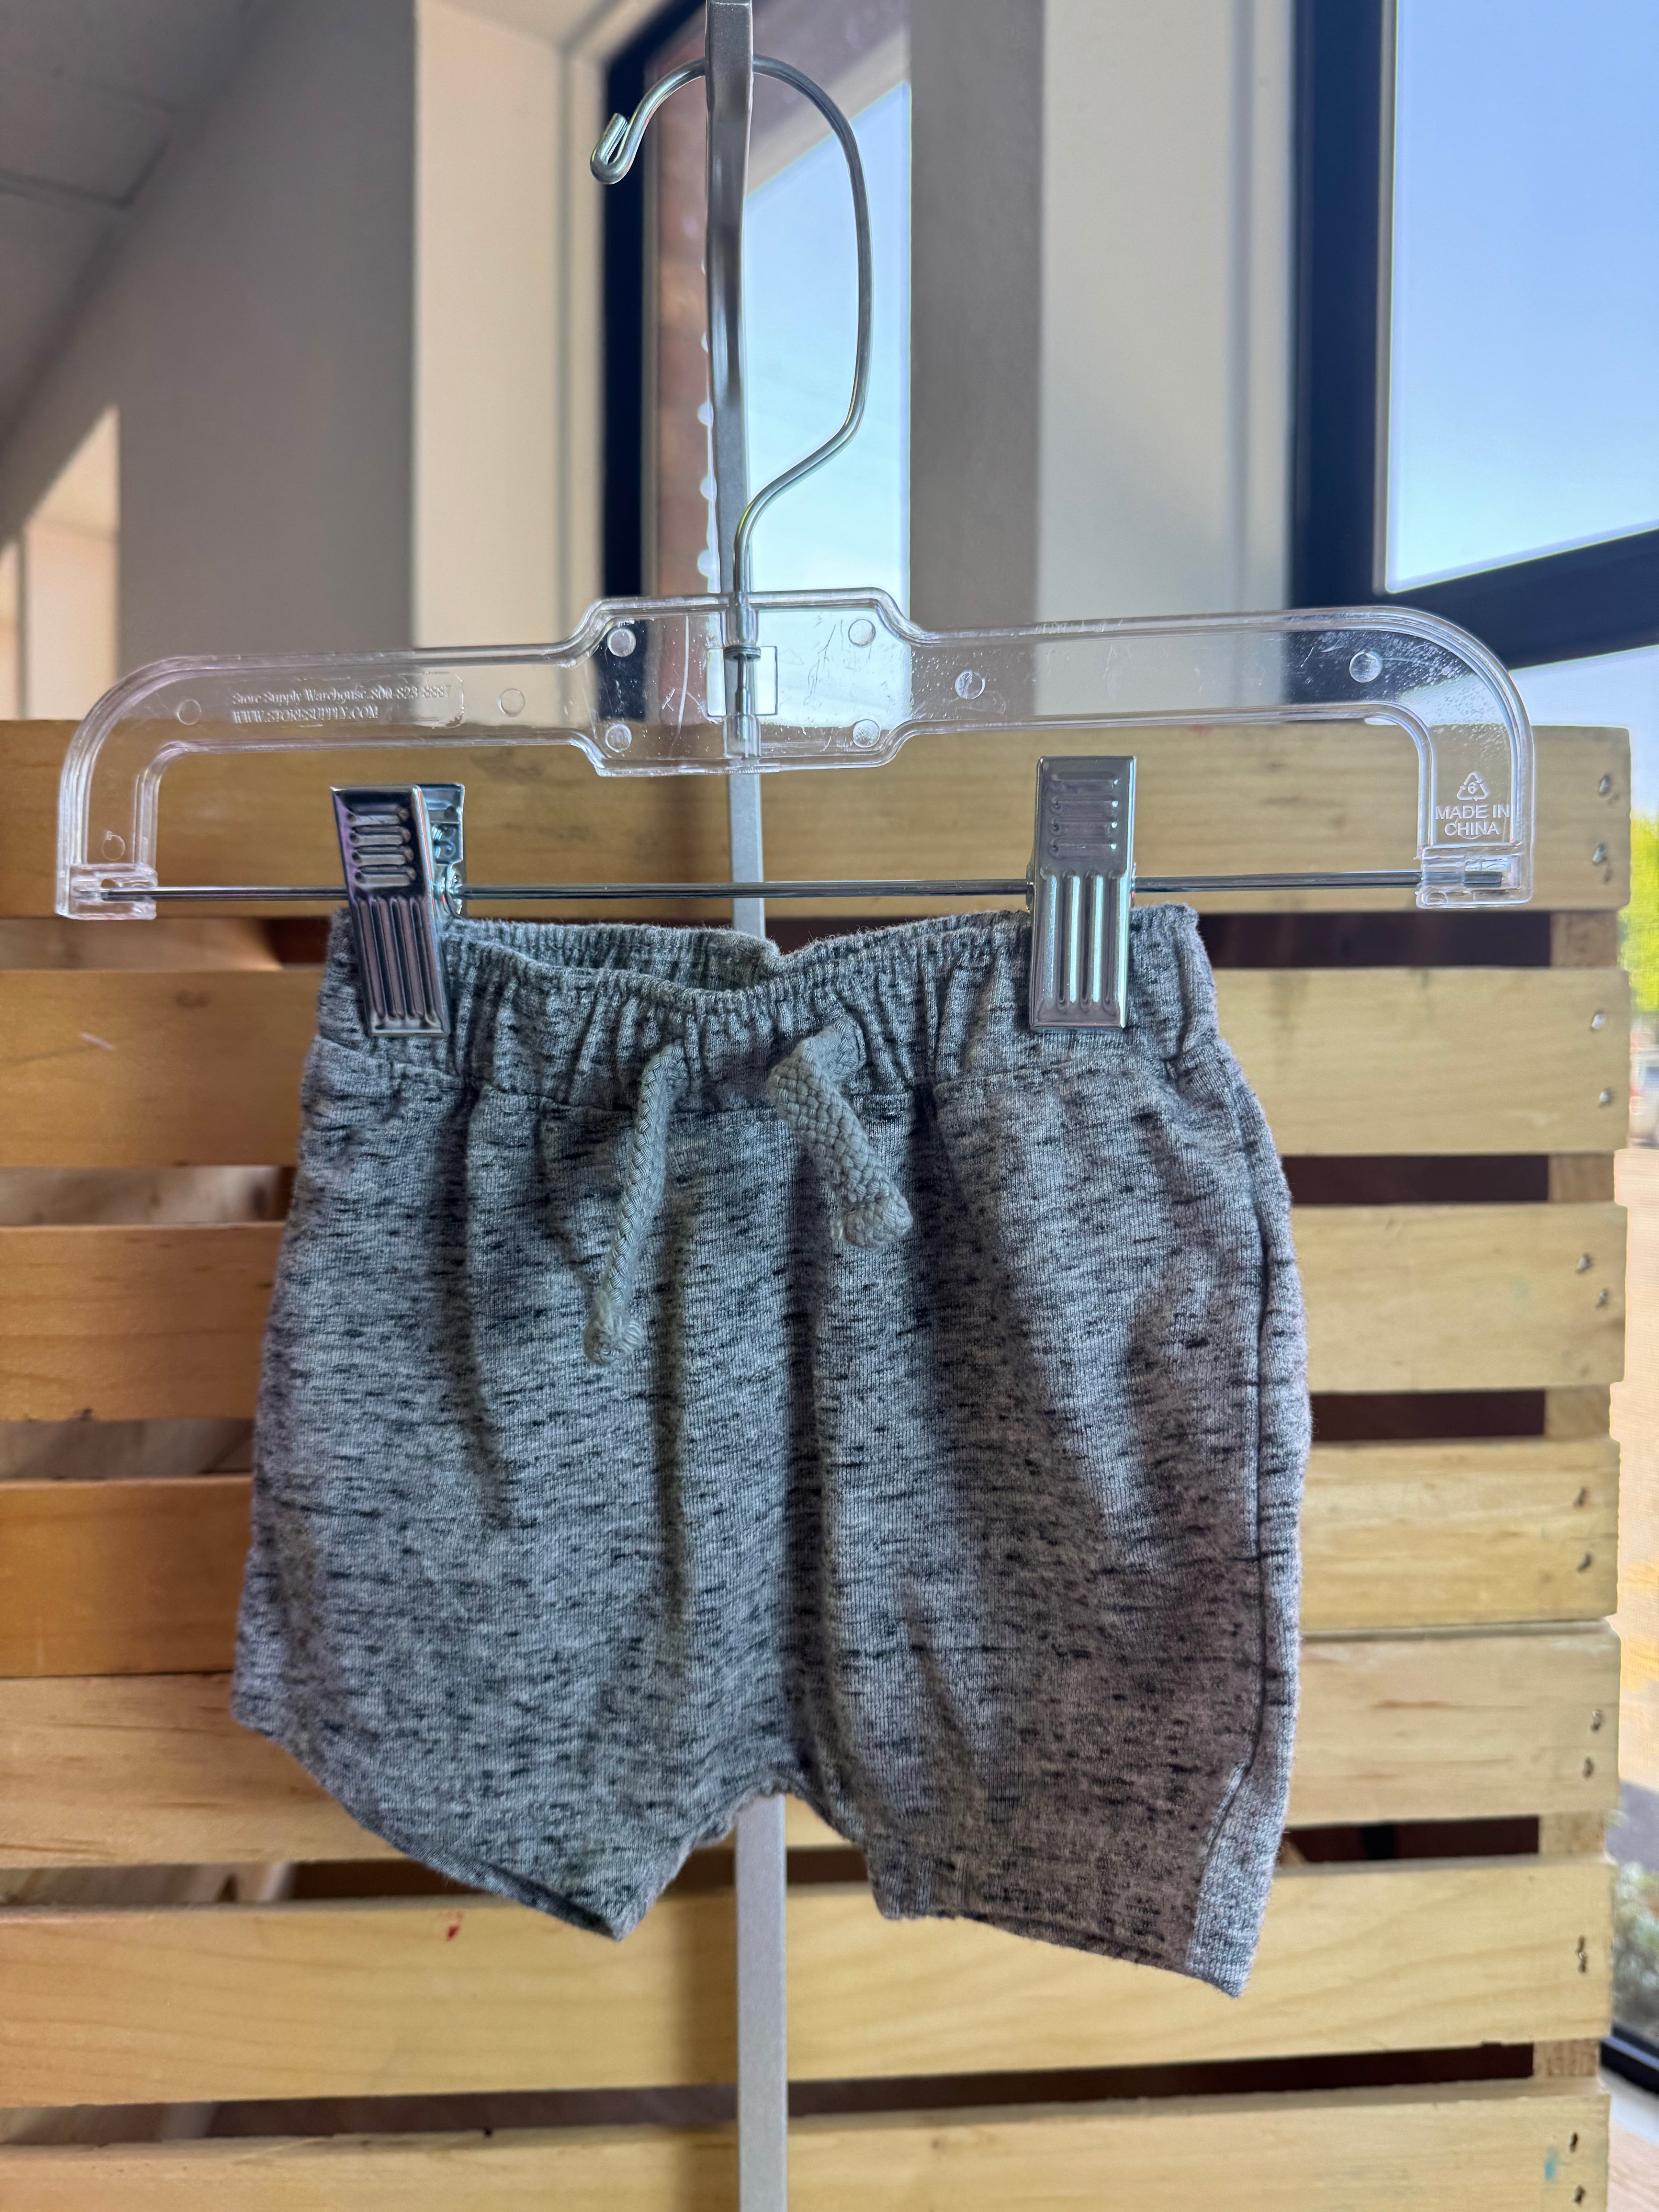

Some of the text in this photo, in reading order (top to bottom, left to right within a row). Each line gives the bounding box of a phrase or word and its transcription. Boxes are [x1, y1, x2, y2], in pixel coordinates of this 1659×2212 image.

[263, 690, 302, 706] Supply
[1468, 782, 1477, 794] 6
[1435, 804, 1510, 819] MADE IN
[1444, 822, 1500, 836] CHINA
